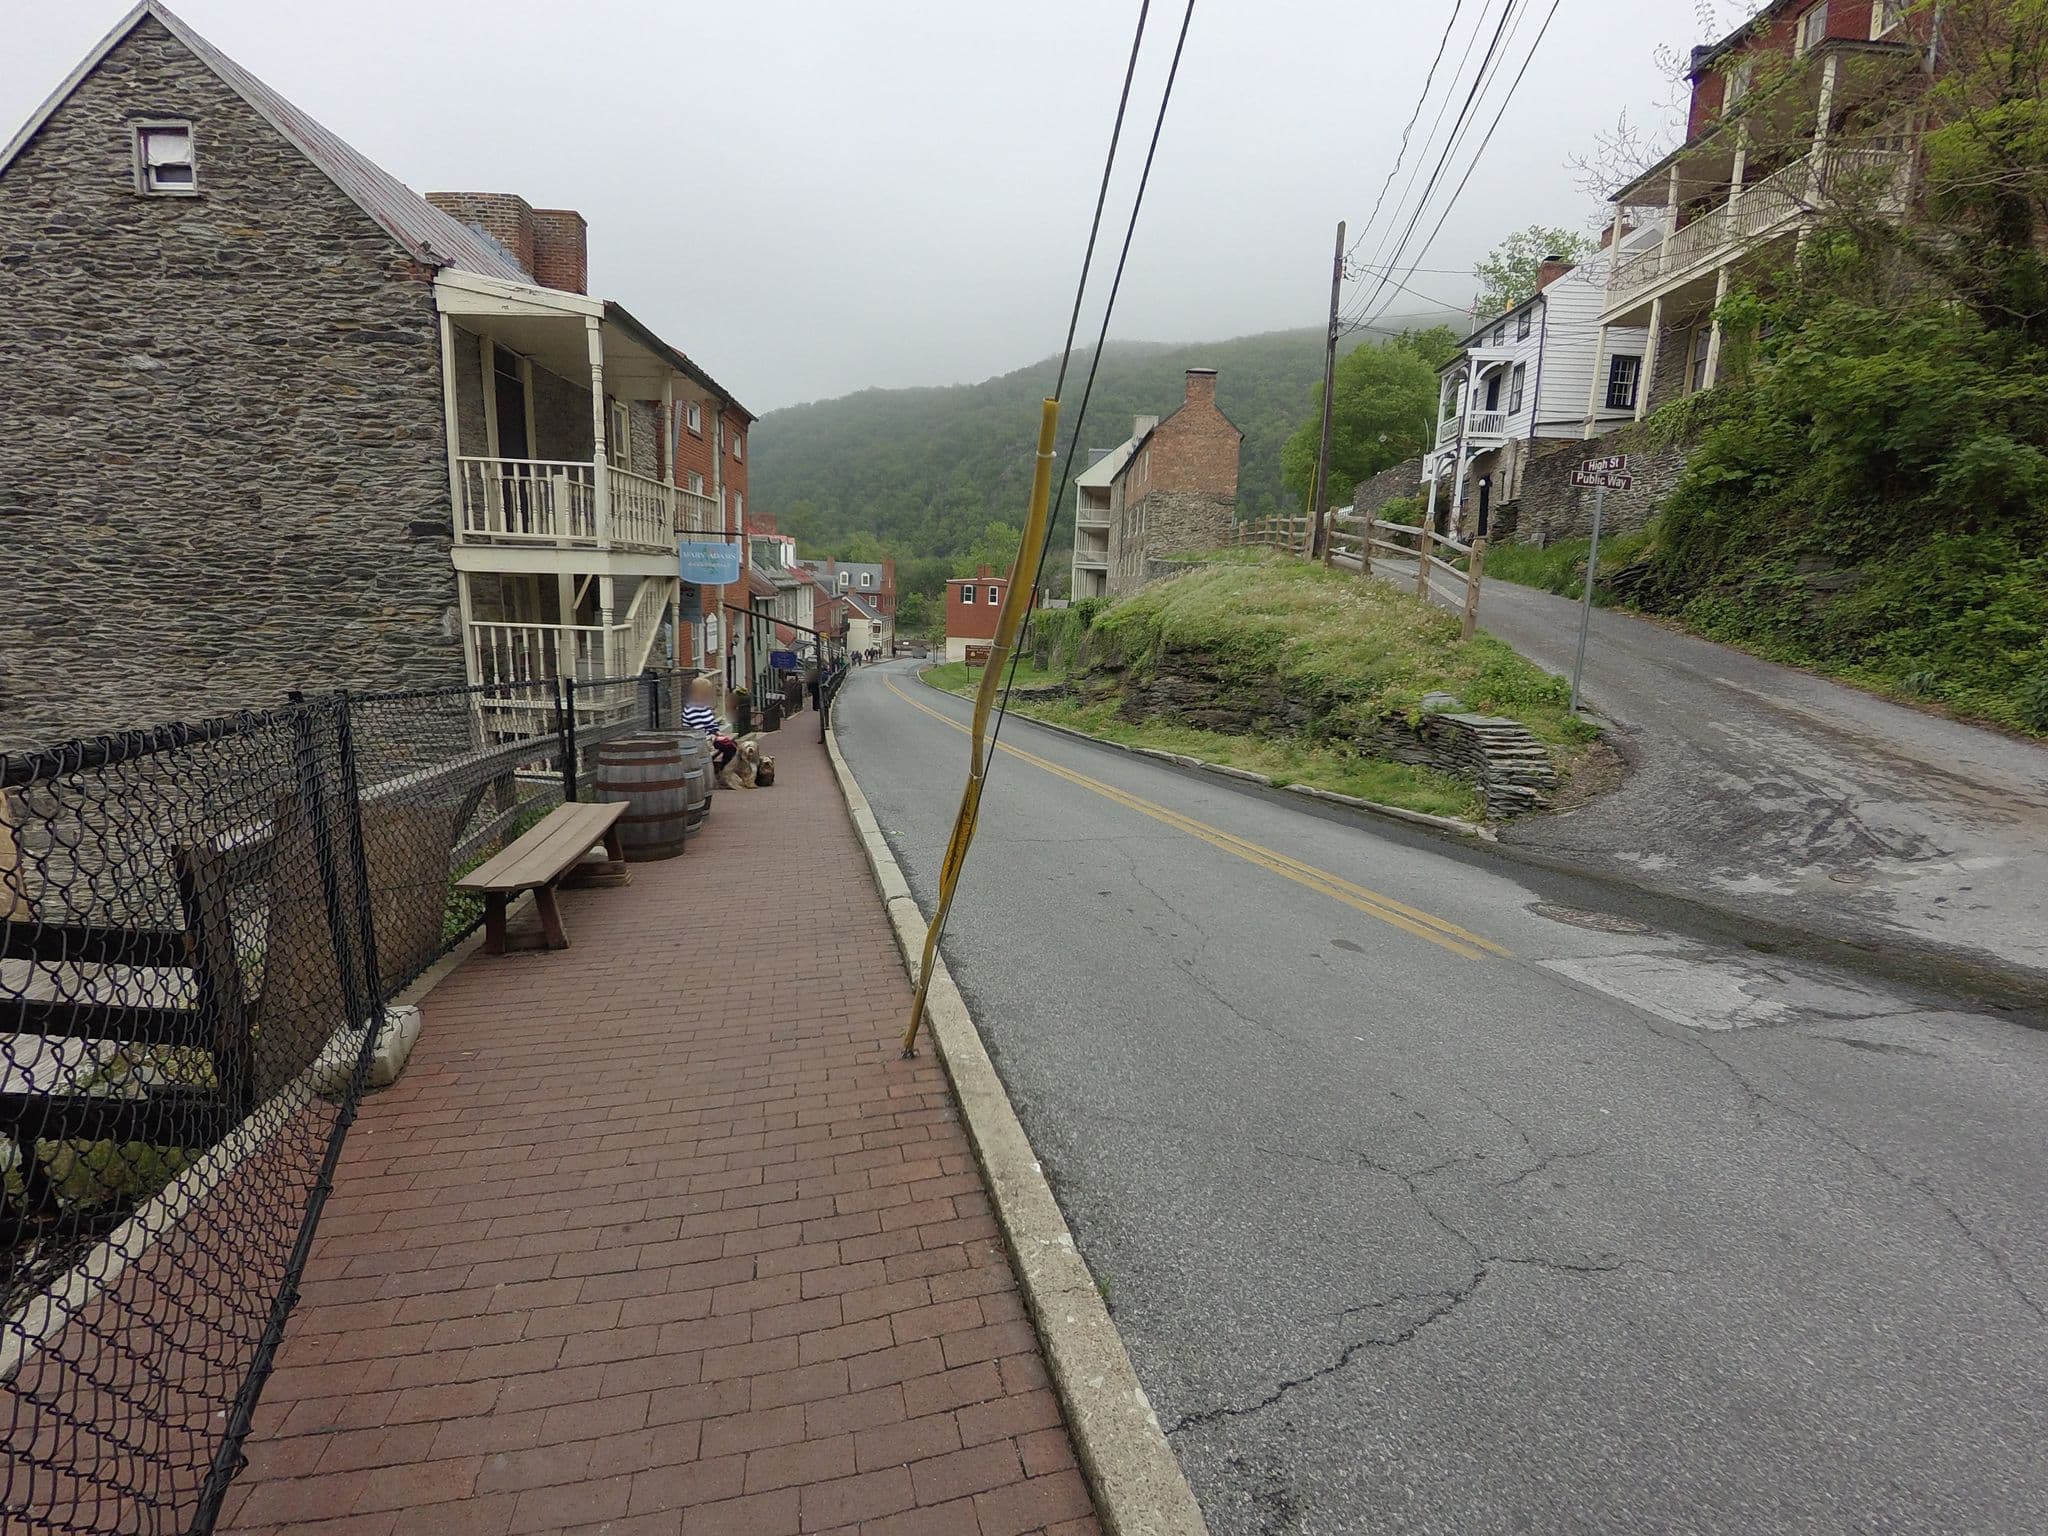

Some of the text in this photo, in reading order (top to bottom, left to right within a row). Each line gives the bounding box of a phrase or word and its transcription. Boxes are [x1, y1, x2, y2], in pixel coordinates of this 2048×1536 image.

[1588, 457, 1619, 472] High St
[1576, 473, 1627, 490] Public Way
